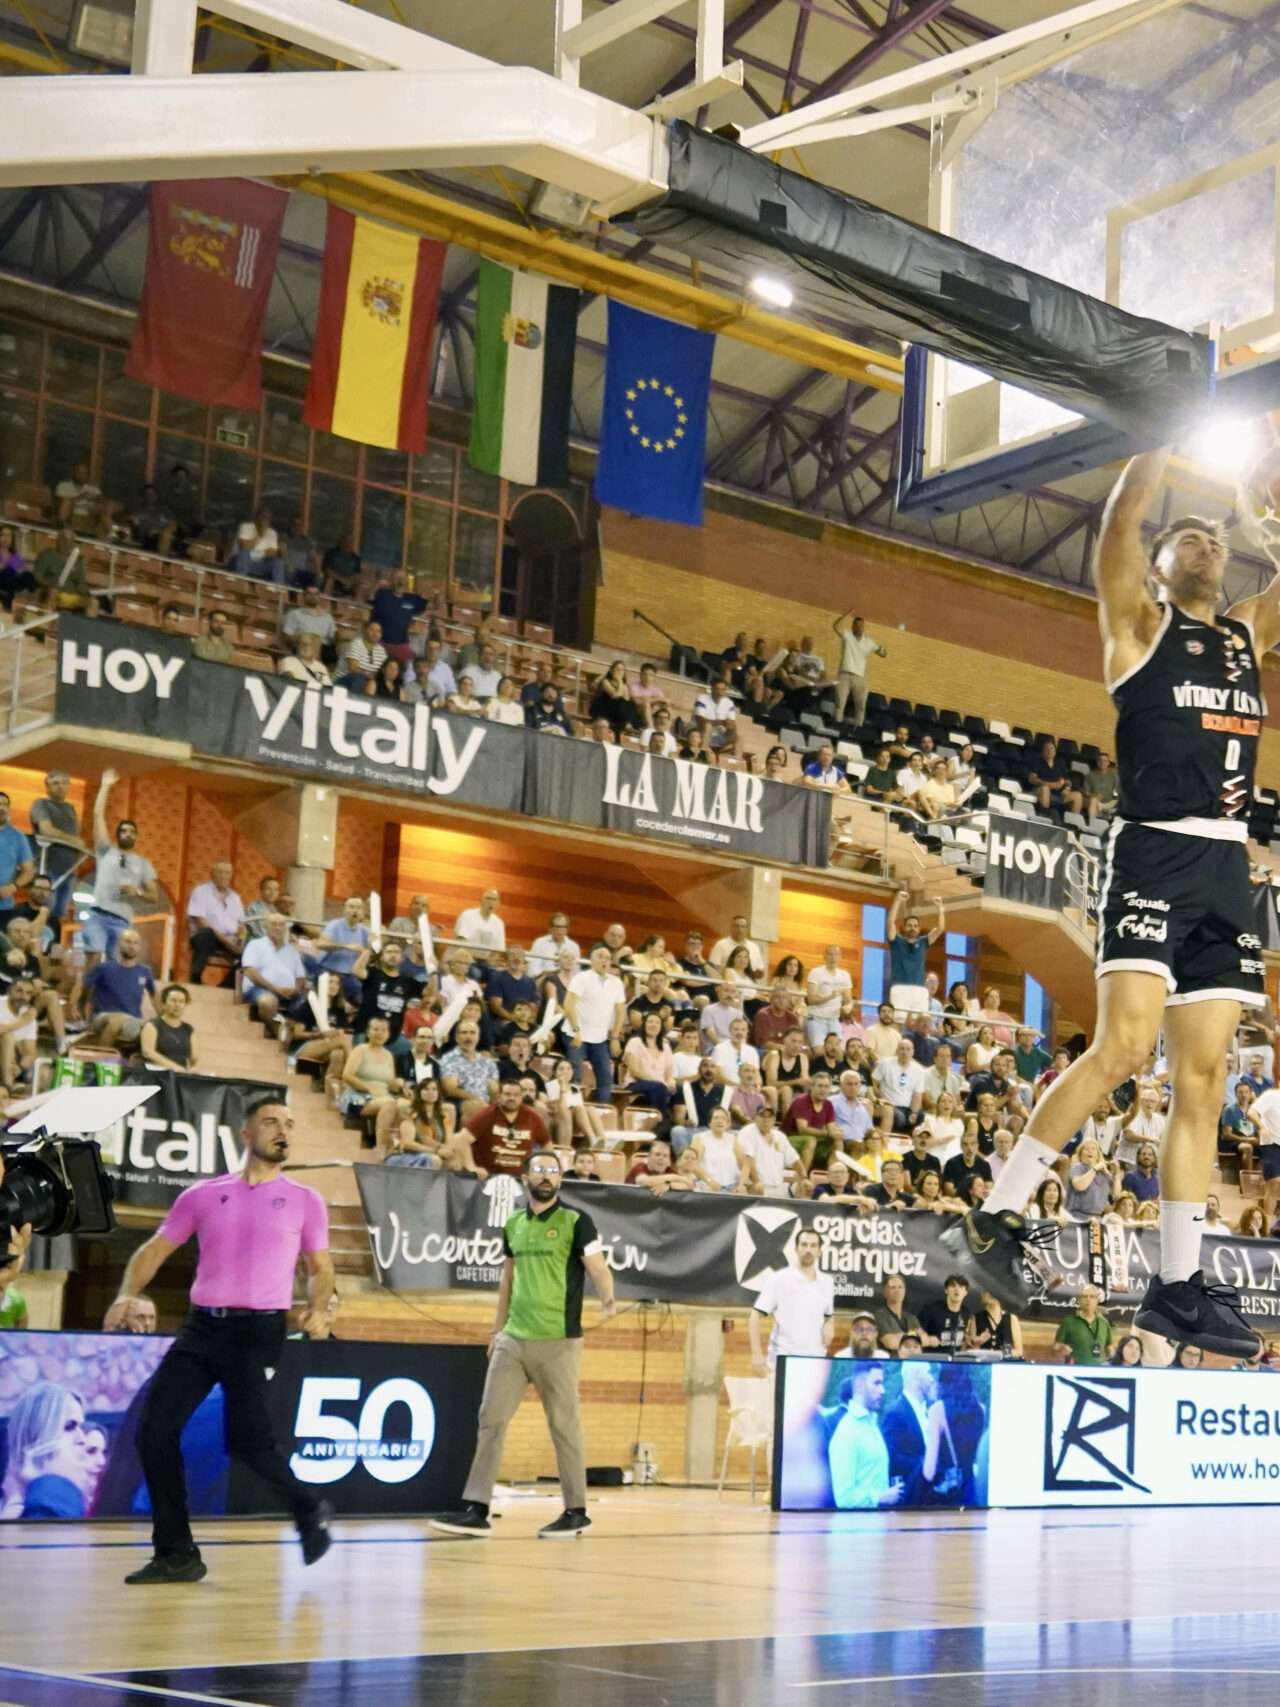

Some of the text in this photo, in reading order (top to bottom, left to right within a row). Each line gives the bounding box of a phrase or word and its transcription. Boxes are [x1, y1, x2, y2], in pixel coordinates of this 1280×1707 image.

[62, 640, 185, 698] HOY
[1225, 739, 1240, 771] 0
[602, 743, 764, 833] LA MAR
[990, 832, 1063, 879] HOY
[368, 1212, 506, 1270] Vicente
[289, 1377, 435, 1484] 50
[302, 1443, 419, 1457] ANIVERSARIO
